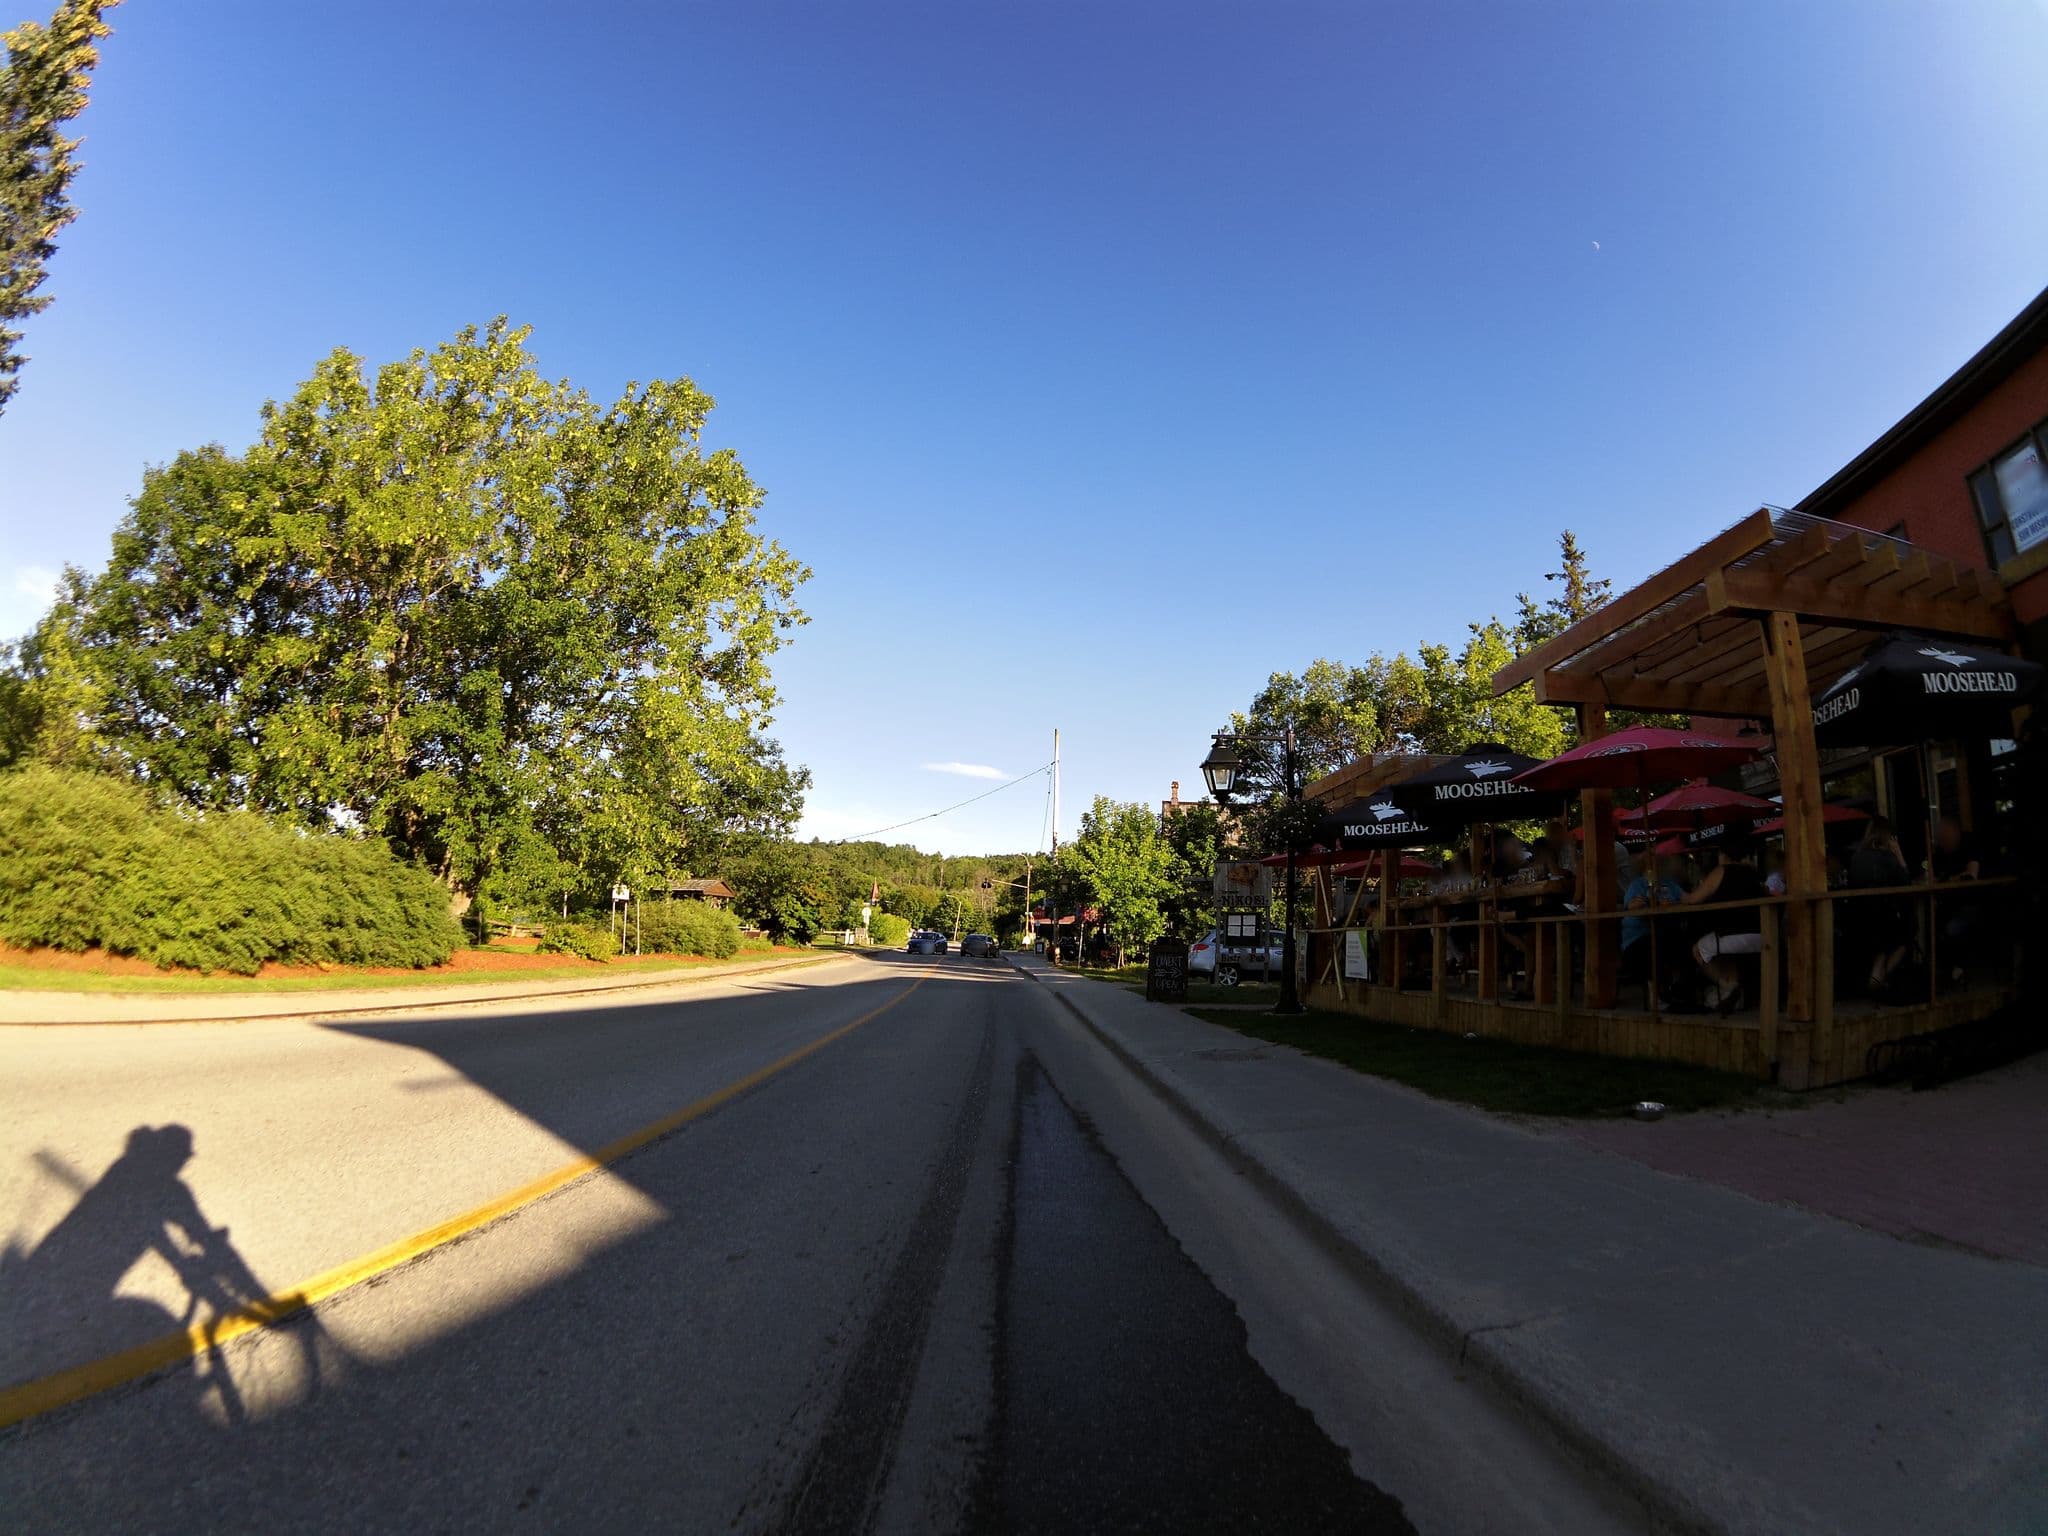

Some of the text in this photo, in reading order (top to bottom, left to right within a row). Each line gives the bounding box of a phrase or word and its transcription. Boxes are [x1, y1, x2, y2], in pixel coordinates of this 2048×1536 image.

[1921, 672, 2017, 694] MOOSEHEAD
[1811, 687, 1860, 726] OSEHEAD
[1434, 780, 1535, 800] MOOSEHEA
